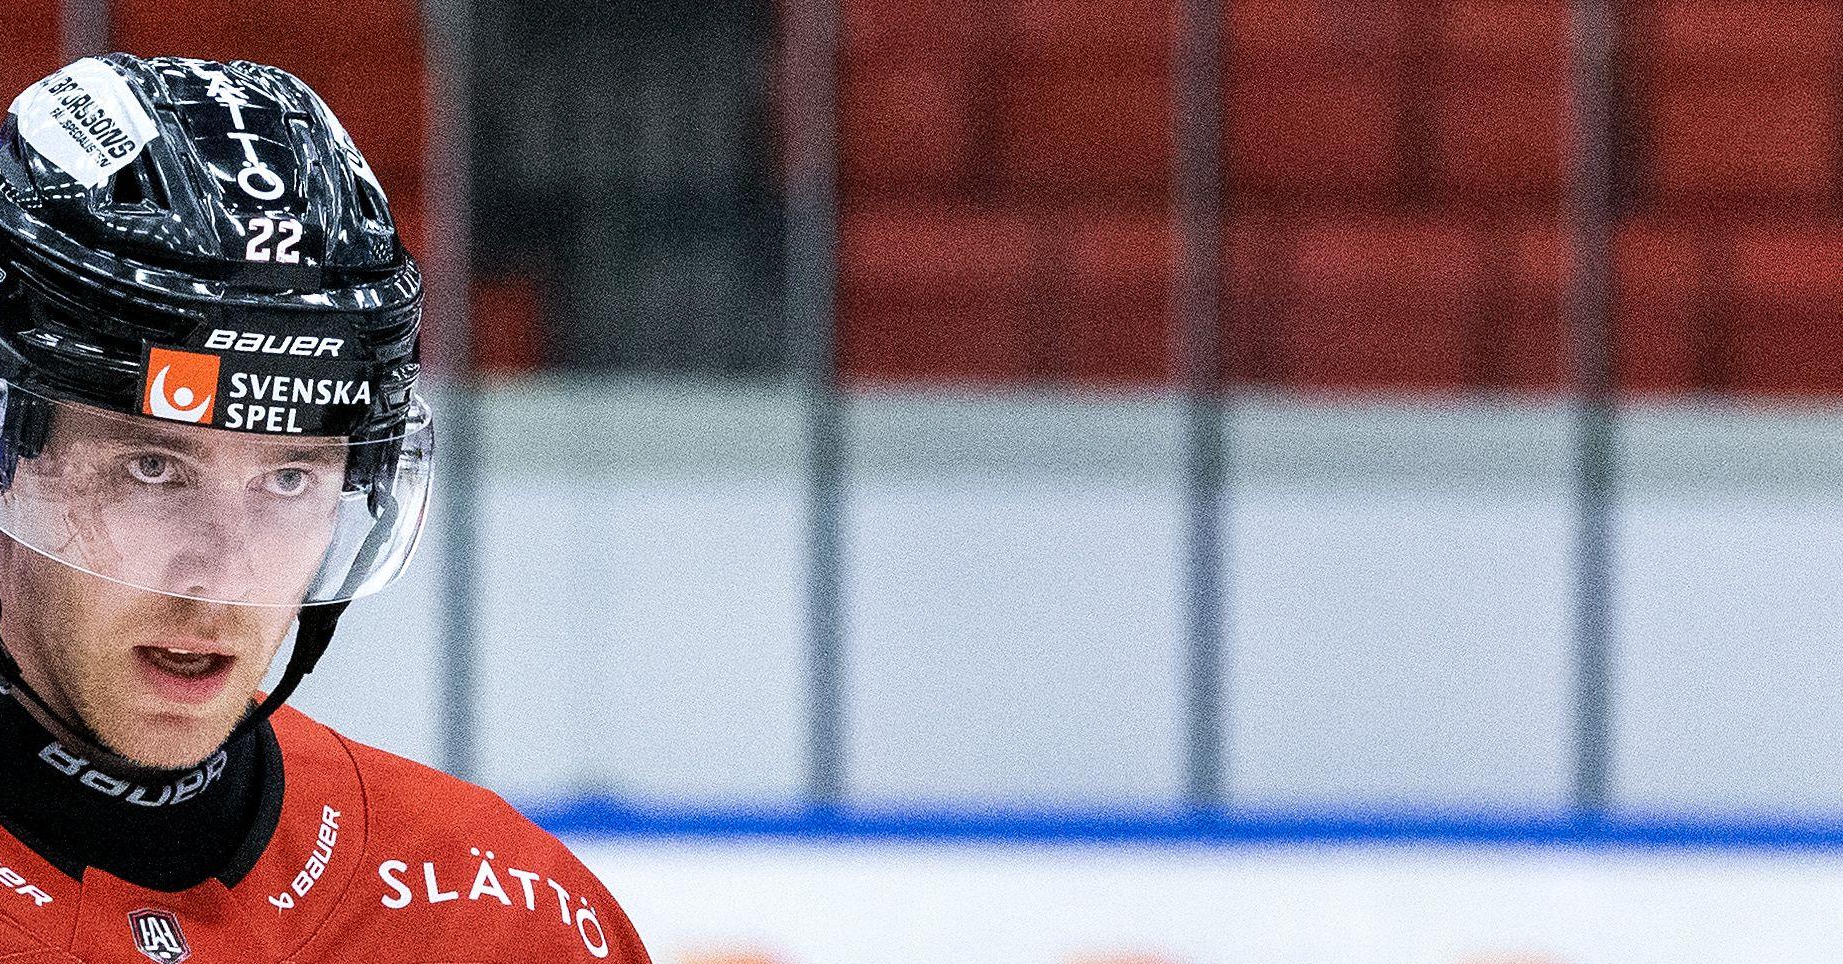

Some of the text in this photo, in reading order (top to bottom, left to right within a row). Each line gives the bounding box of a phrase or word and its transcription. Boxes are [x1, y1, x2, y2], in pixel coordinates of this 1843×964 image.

[244, 216, 304, 265] 22
[203, 328, 345, 358] BAUER
[229, 372, 372, 406] SVENSKA
[224, 402, 303, 434] SPEL
[379, 847, 610, 959] SLÄTTÖ
